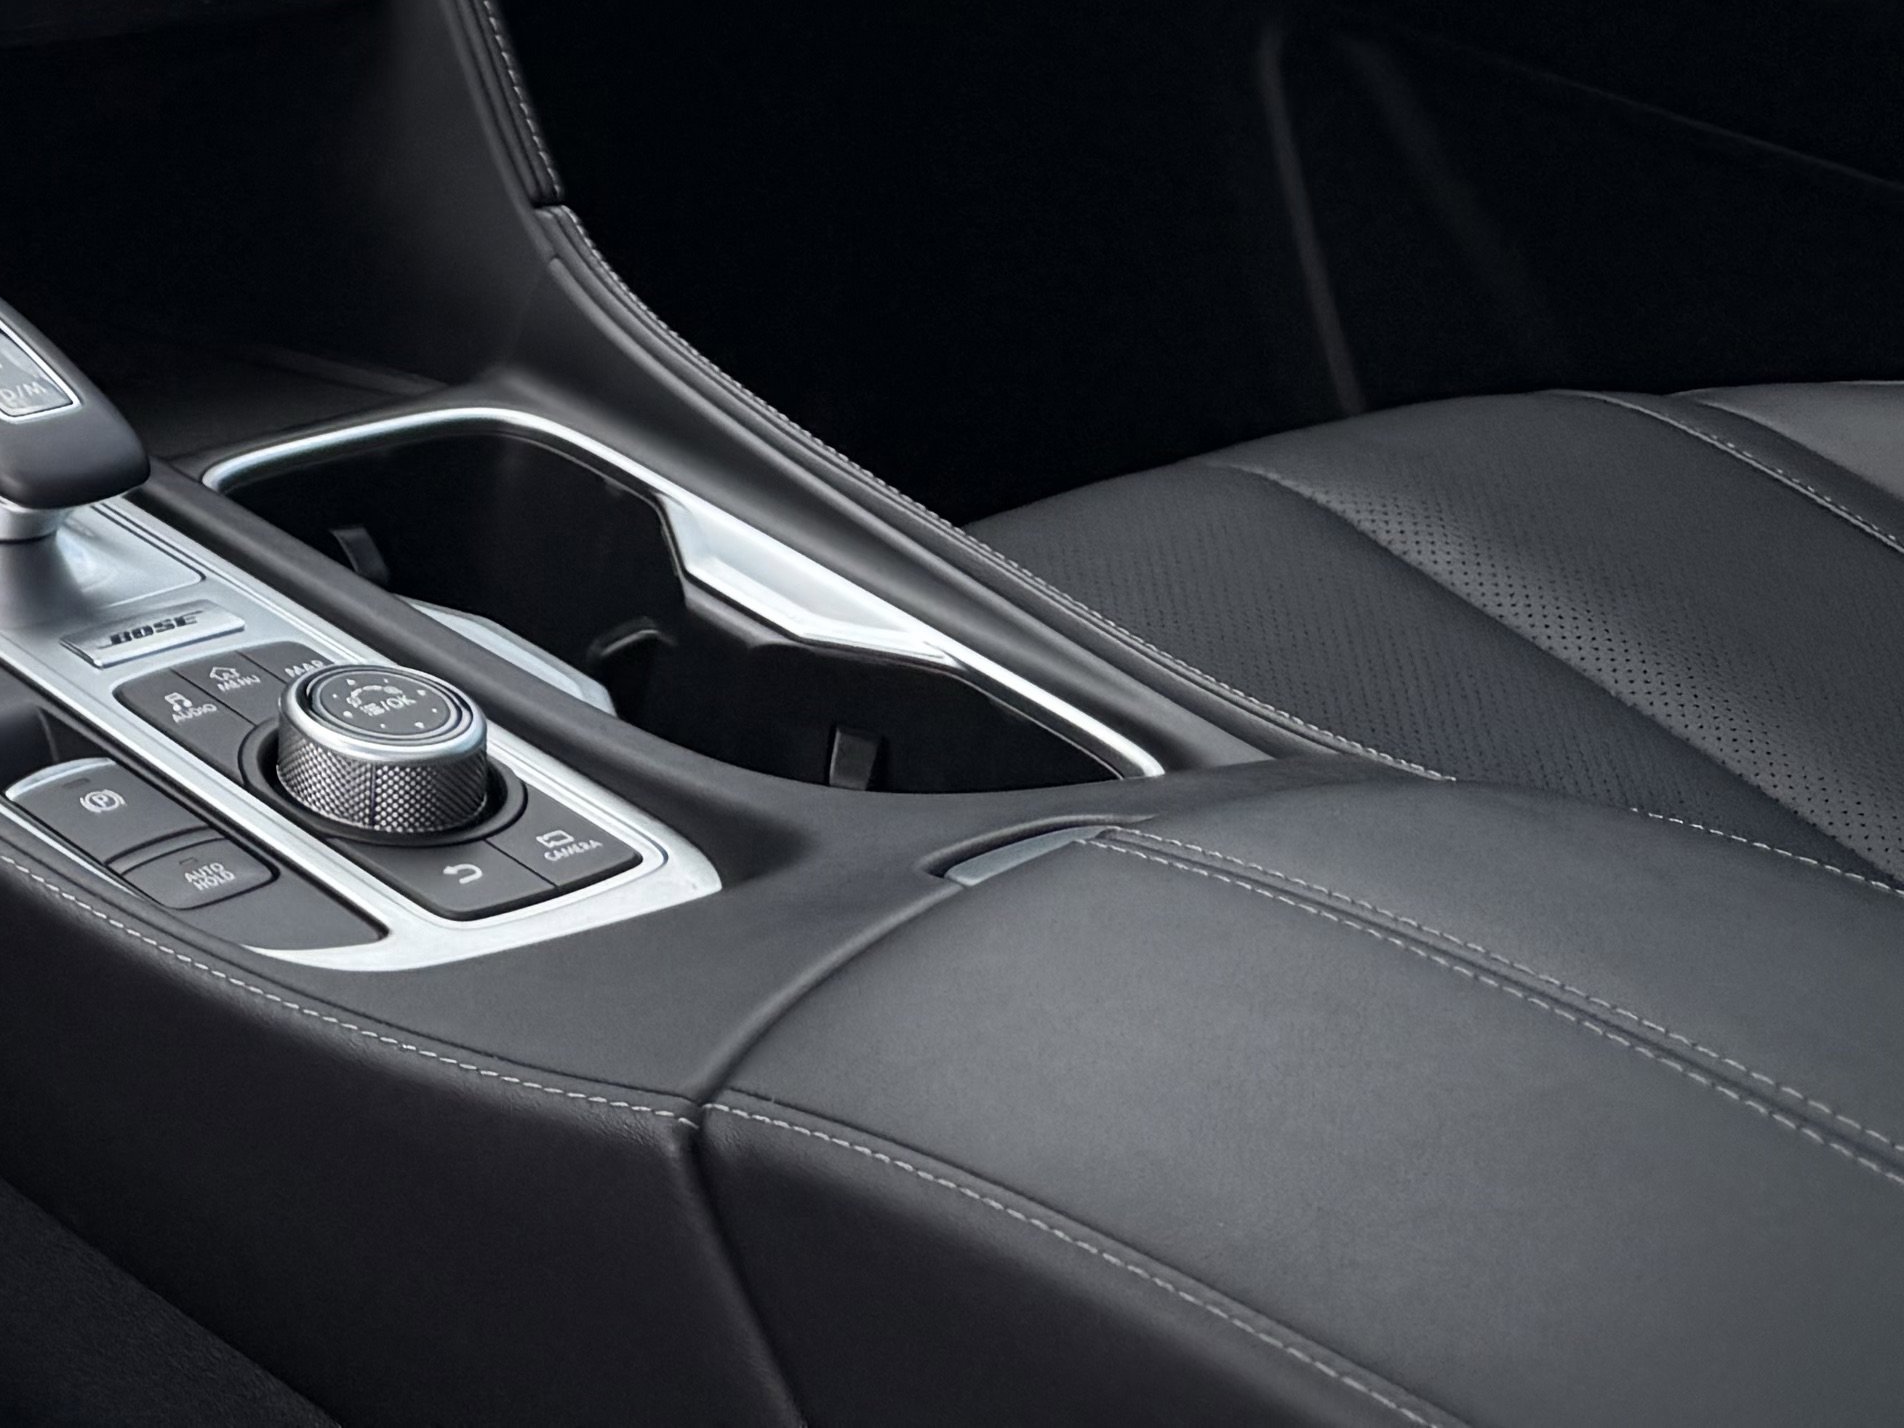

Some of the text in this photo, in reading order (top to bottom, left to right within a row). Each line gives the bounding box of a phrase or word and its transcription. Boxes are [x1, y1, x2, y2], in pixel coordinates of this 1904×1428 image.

[109, 611, 201, 648] BOSE
[285, 659, 325, 678] MAP
[217, 674, 261, 693] MENU
[172, 702, 218, 723] AUDIO
[543, 839, 602, 862] CAMERA
[183, 861, 225, 882] AUTO
[190, 870, 236, 893] HOLD
